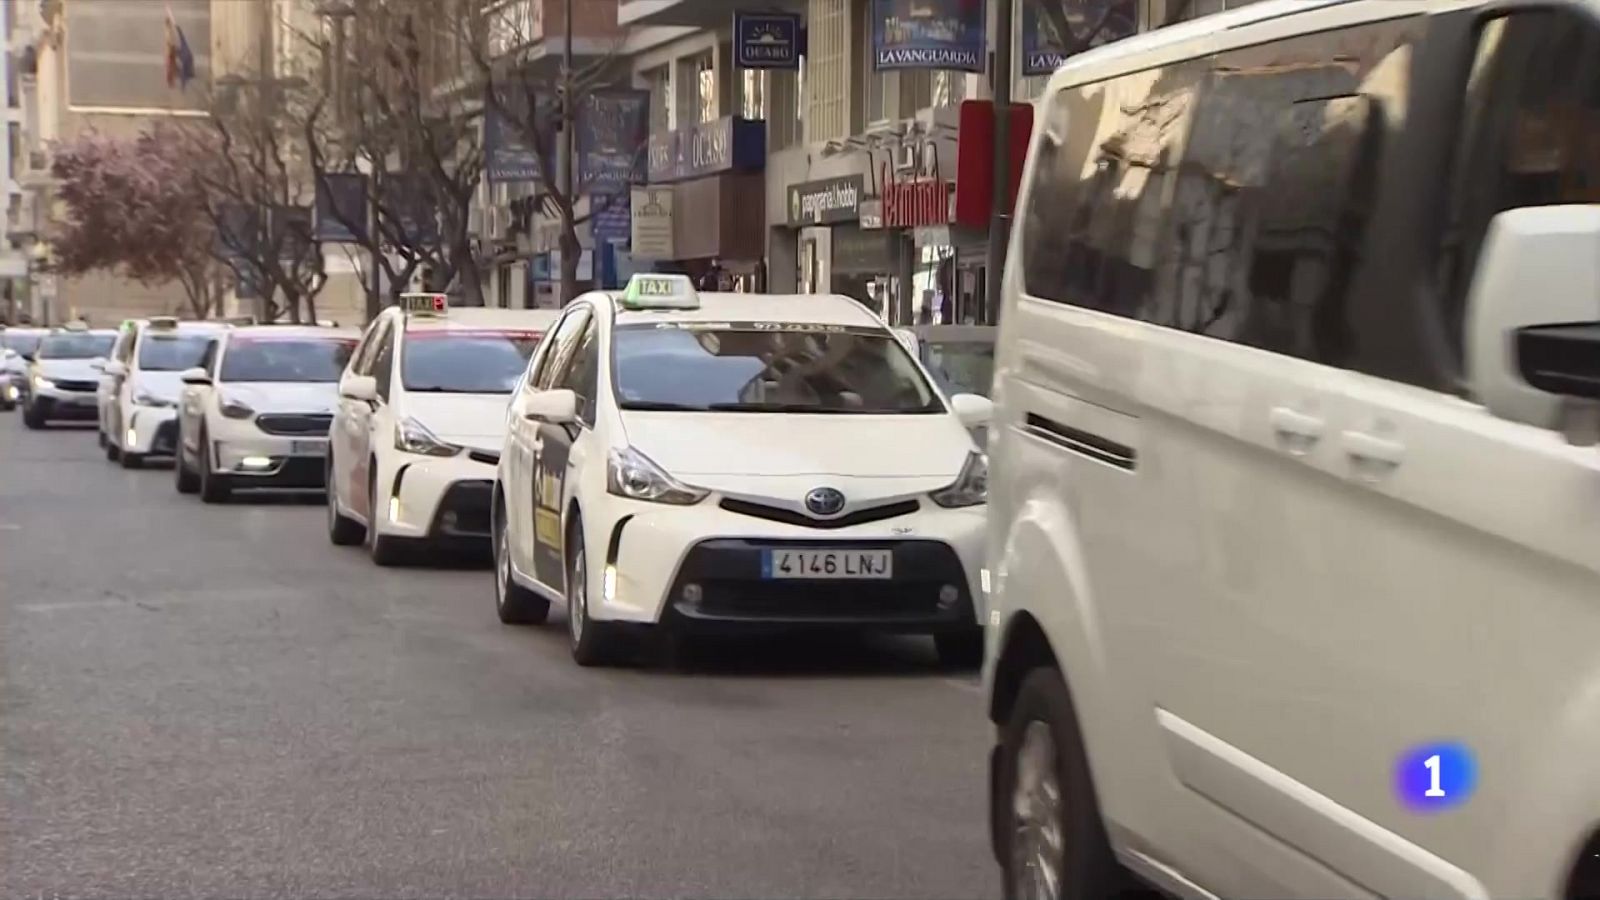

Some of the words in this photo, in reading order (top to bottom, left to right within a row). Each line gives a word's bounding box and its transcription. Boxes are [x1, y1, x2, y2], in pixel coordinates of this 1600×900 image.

[880, 51, 895, 64] LA
[896, 49, 976, 65] VANGUARDIA
[693, 130, 727, 168] OCASO
[642, 281, 672, 294] TAXI
[780, 553, 836, 575] 4146
[845, 553, 887, 575] LNJ
